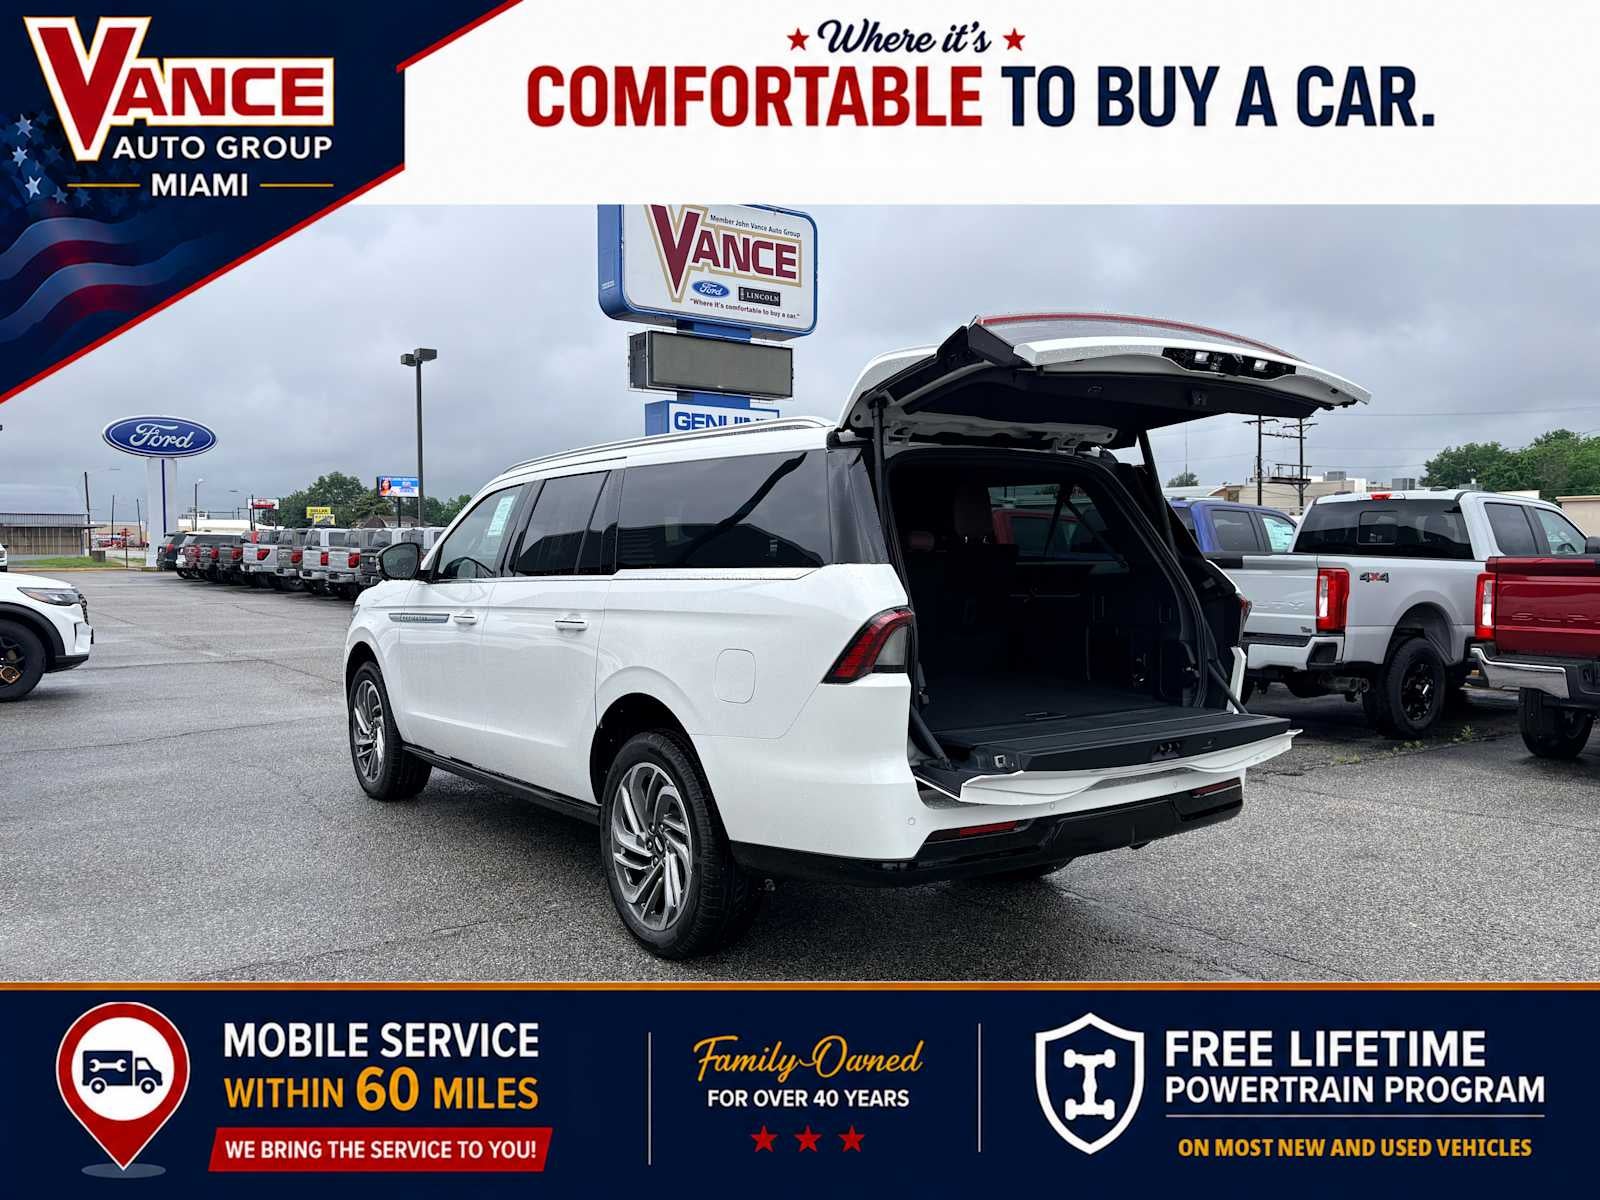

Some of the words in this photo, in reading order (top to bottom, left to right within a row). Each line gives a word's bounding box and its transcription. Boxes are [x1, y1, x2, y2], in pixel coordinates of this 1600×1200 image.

[710, 214, 734, 225] Member
[736, 220, 750, 229] John
[751, 222, 768, 232] Vance
[768, 226, 782, 234] Auto
[783, 228, 801, 238] Group
[649, 205, 798, 294] VANCE
[699, 282, 722, 296] Ford
[746, 291, 779, 302] LINCOLN
[725, 303, 762, 314] comfortable
[674, 411, 767, 431] GENU
[129, 422, 194, 448] Ford
